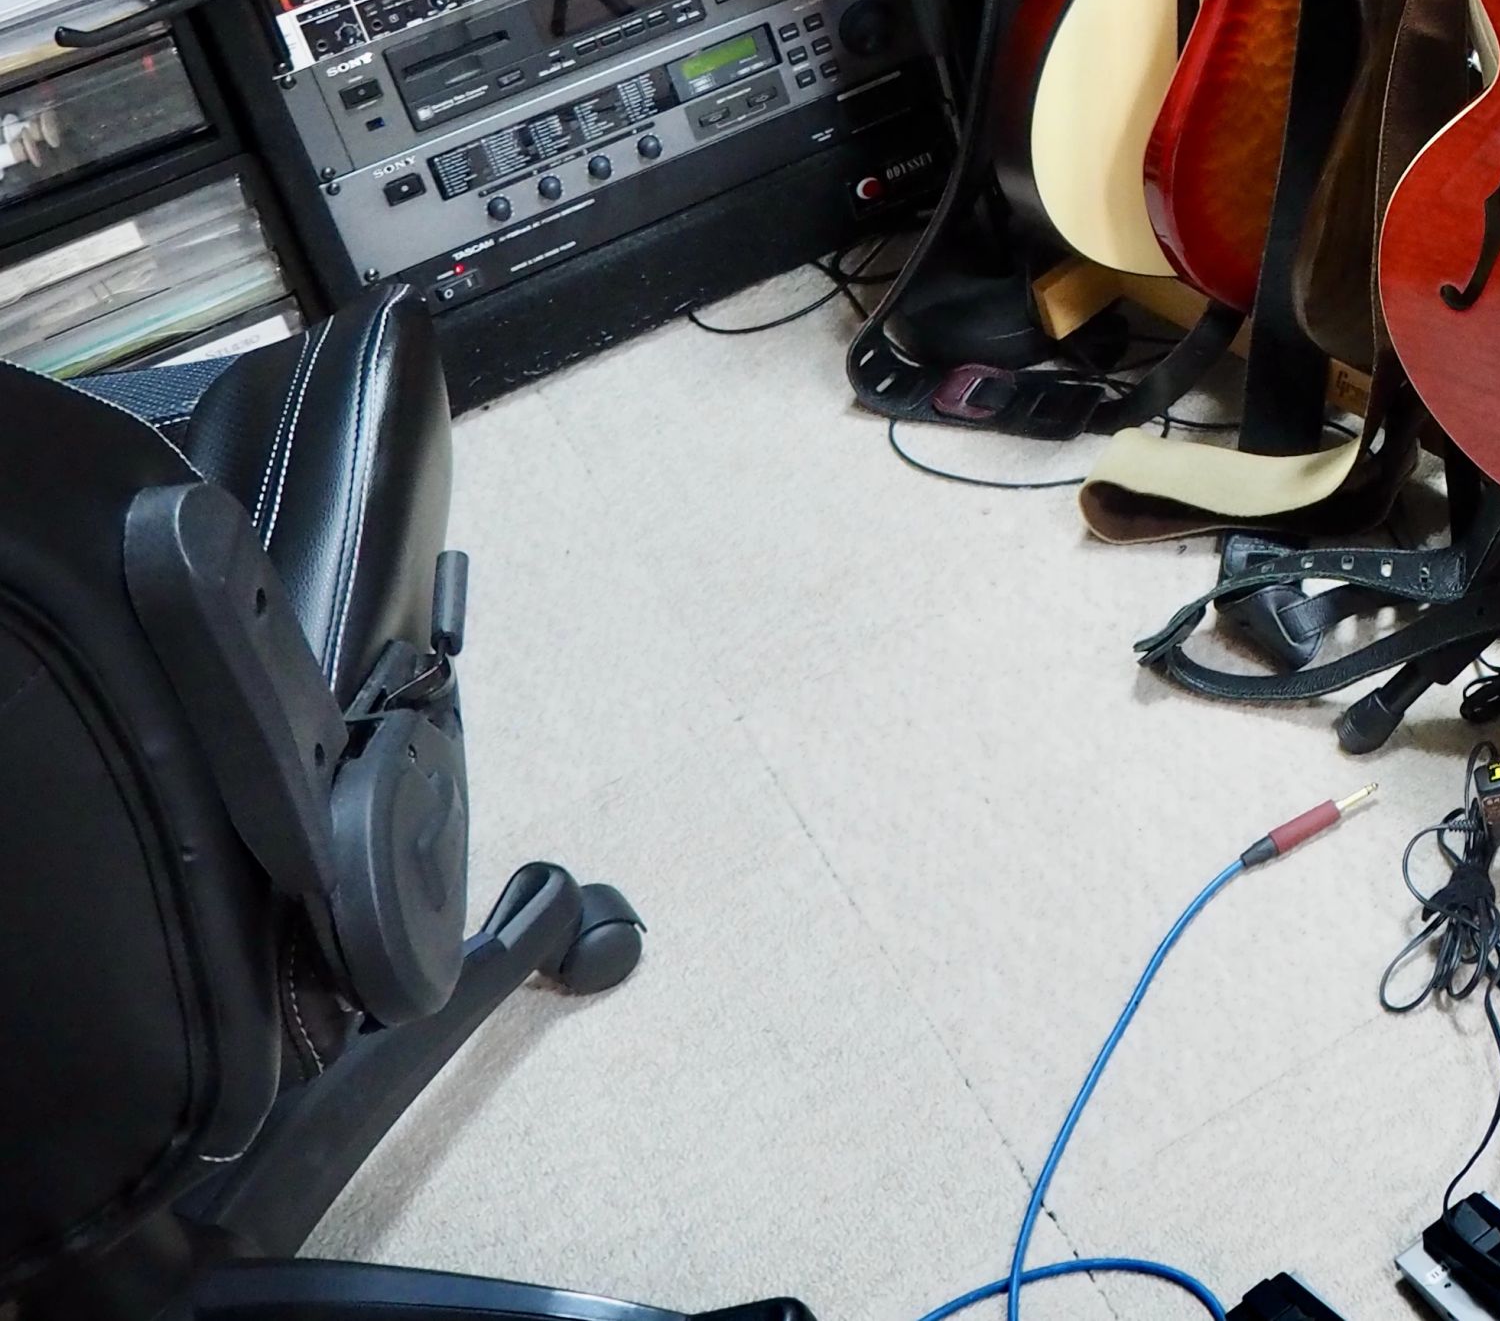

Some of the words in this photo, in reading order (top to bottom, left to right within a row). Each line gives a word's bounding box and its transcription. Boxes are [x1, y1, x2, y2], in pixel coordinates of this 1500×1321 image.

[326, 52, 375, 78] SONY
[373, 155, 417, 179] SONY
[452, 238, 496, 261] TASCAM
